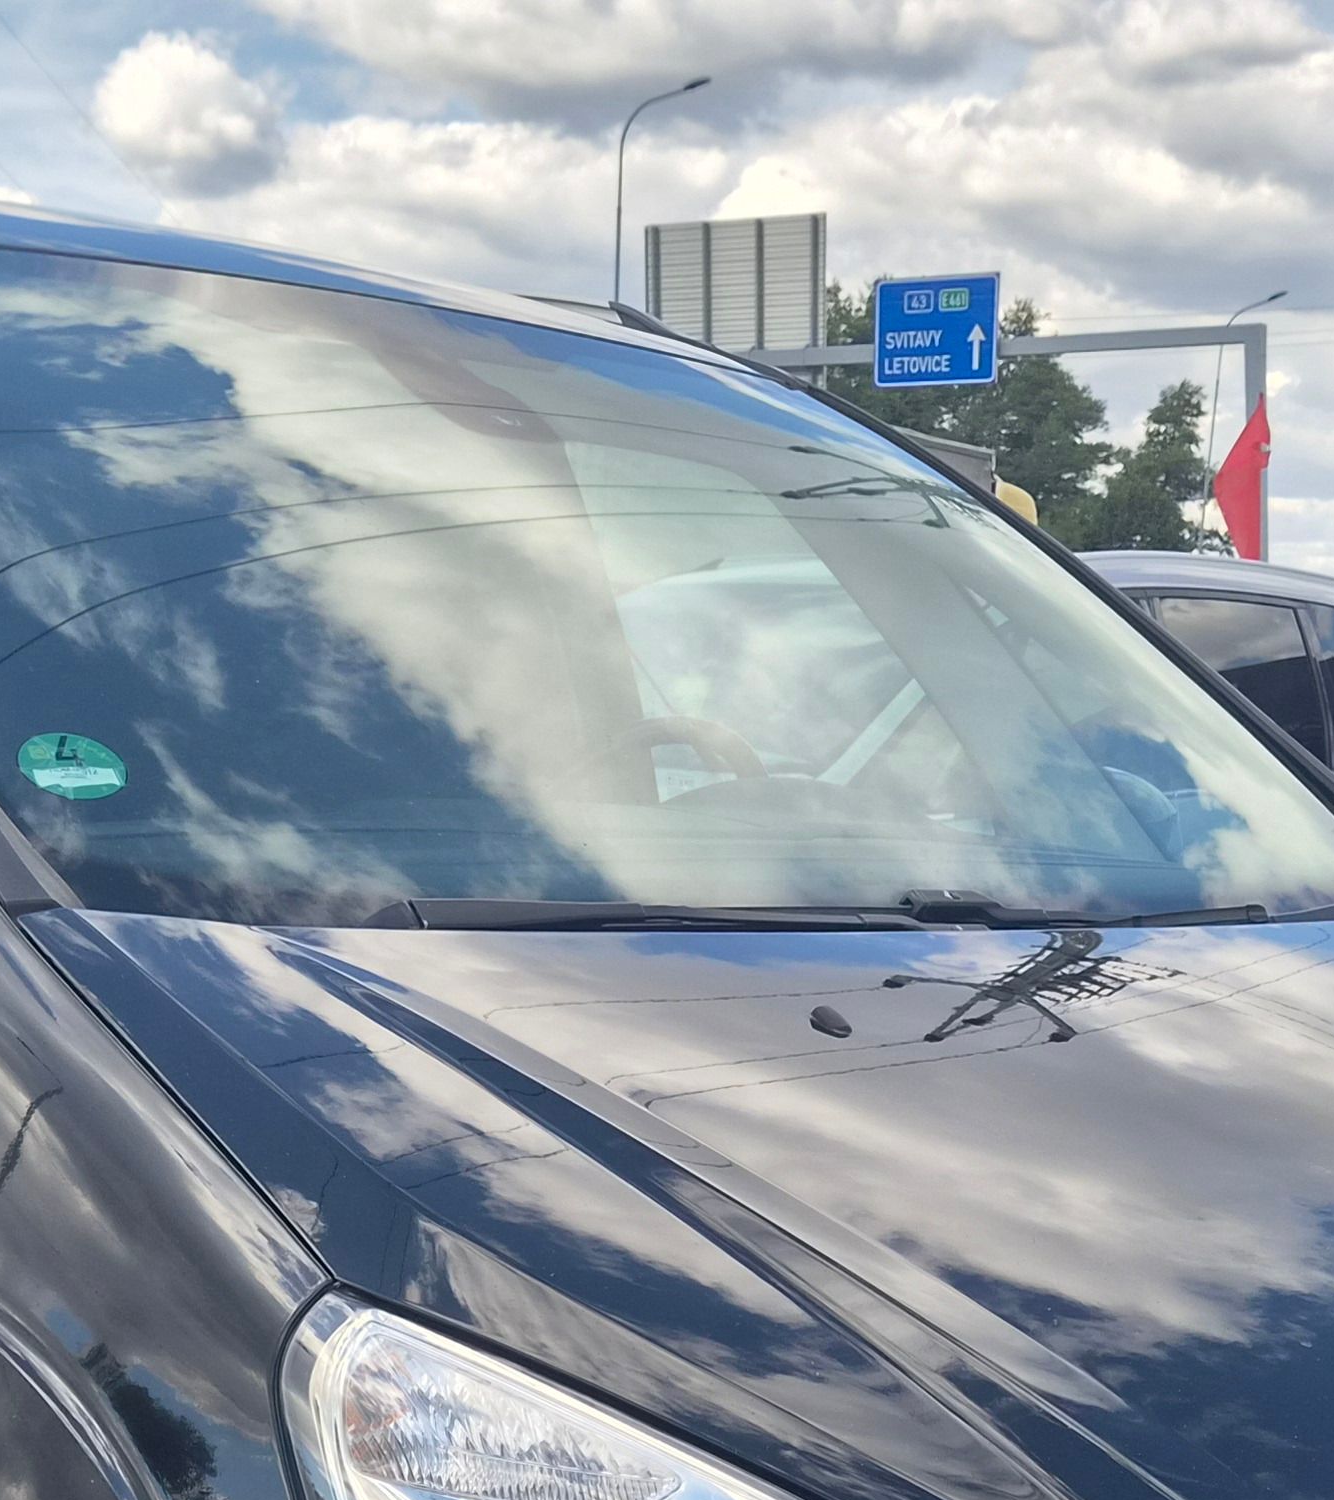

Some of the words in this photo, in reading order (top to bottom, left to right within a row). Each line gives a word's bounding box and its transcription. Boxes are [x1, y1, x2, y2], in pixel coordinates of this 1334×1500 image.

[911, 294, 927, 308] 43
[885, 330, 943, 349] SVITAVY
[884, 354, 951, 375] LETOVICE
